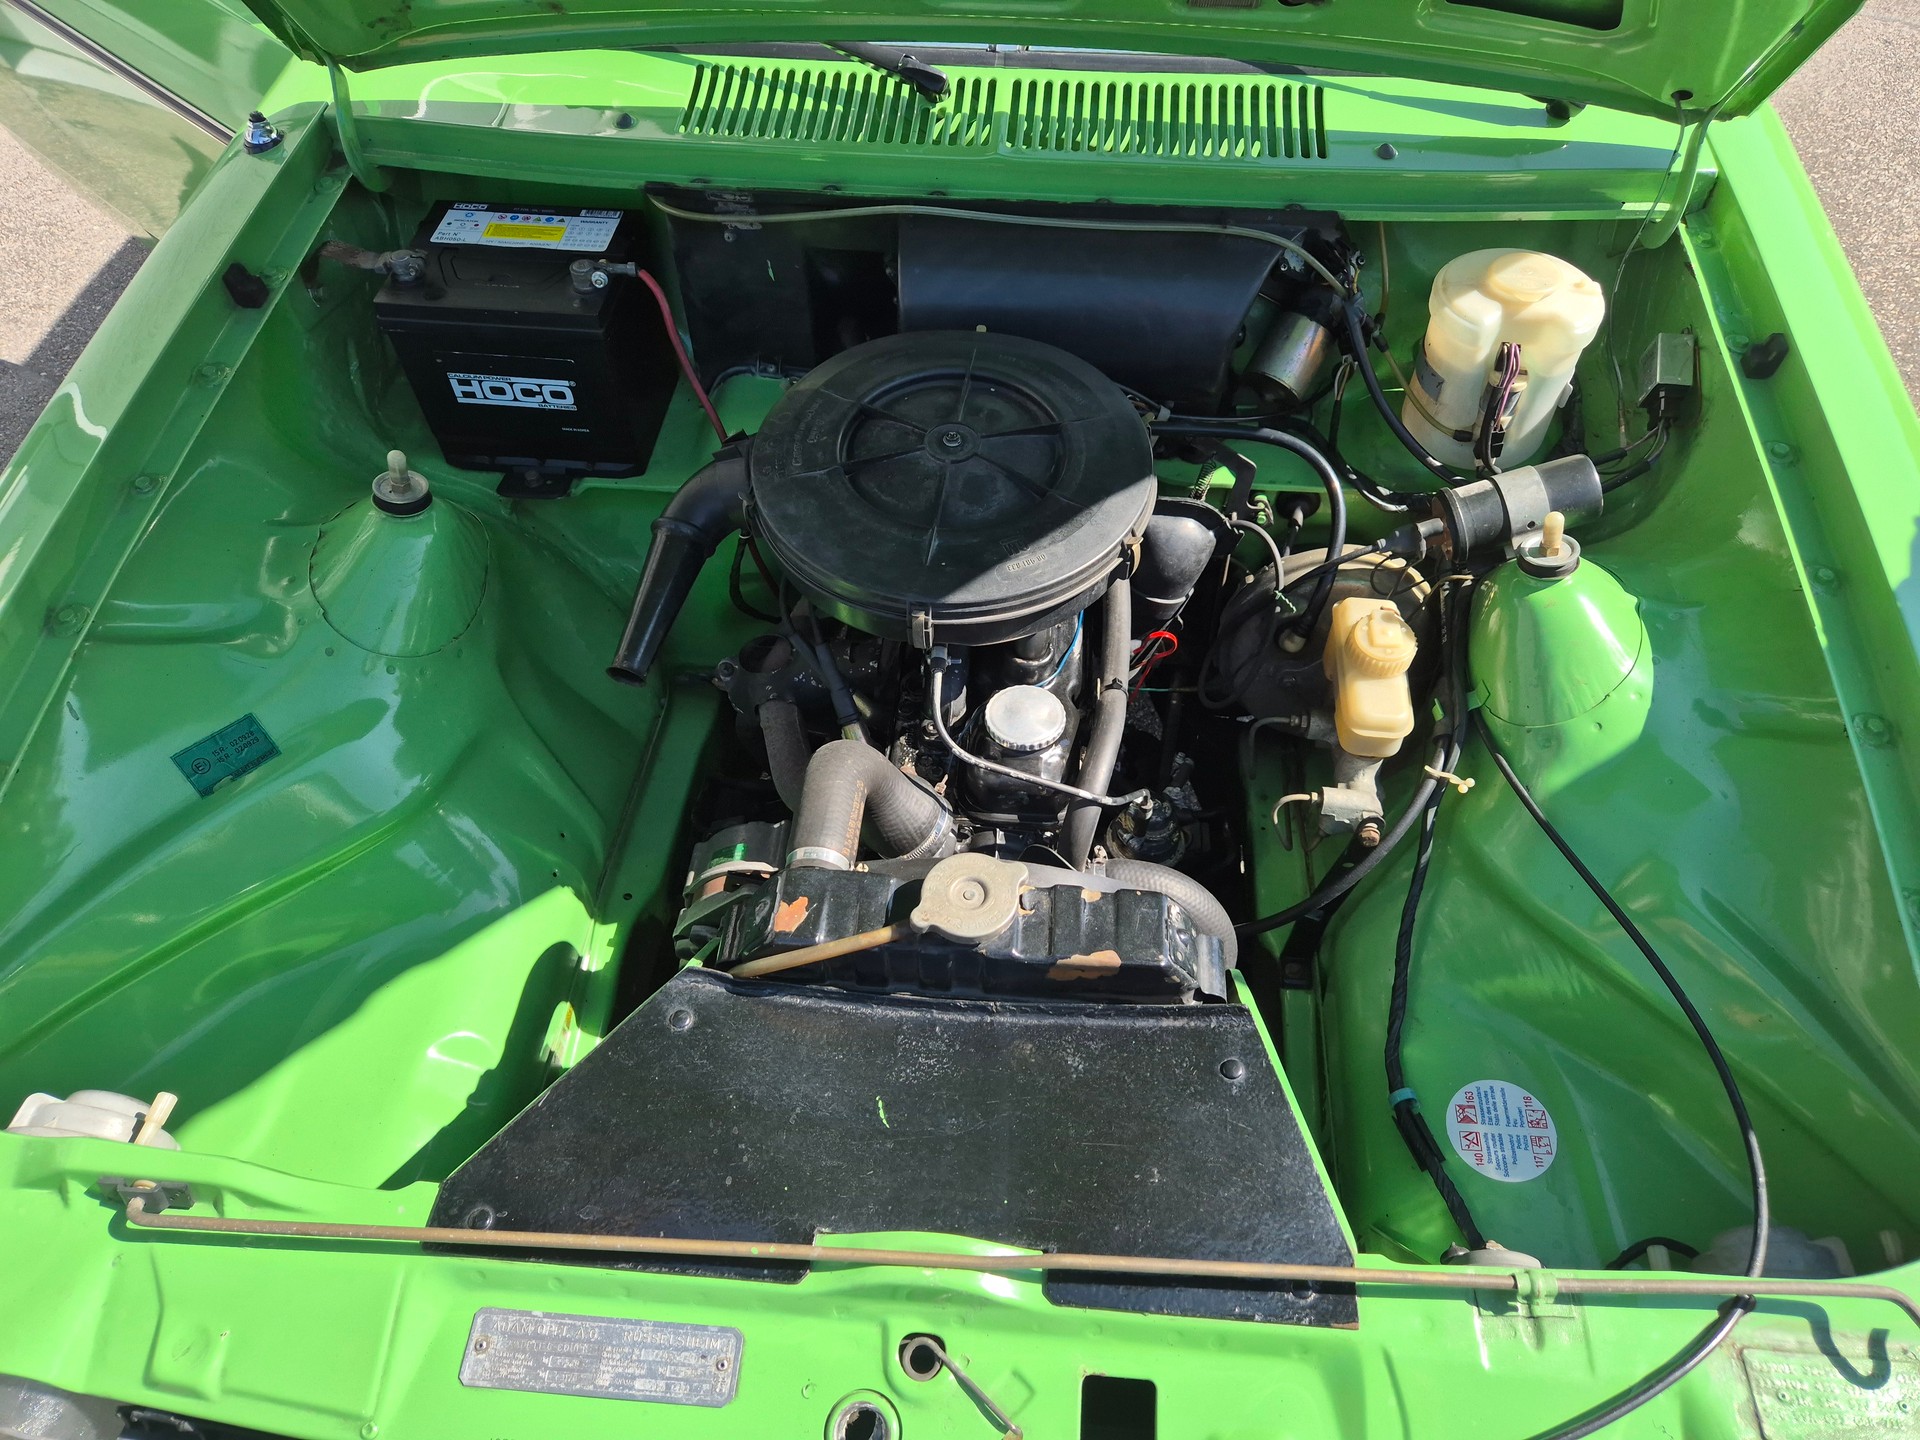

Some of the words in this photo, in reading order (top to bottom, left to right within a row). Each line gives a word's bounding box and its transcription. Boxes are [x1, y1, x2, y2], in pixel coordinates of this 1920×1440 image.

[449, 378, 575, 405] HOCO
[1465, 1091, 1474, 1103] 163
[1523, 1096, 1533, 1107] 118
[1474, 1153, 1484, 1166] 140
[1534, 1156, 1544, 1168] 117
